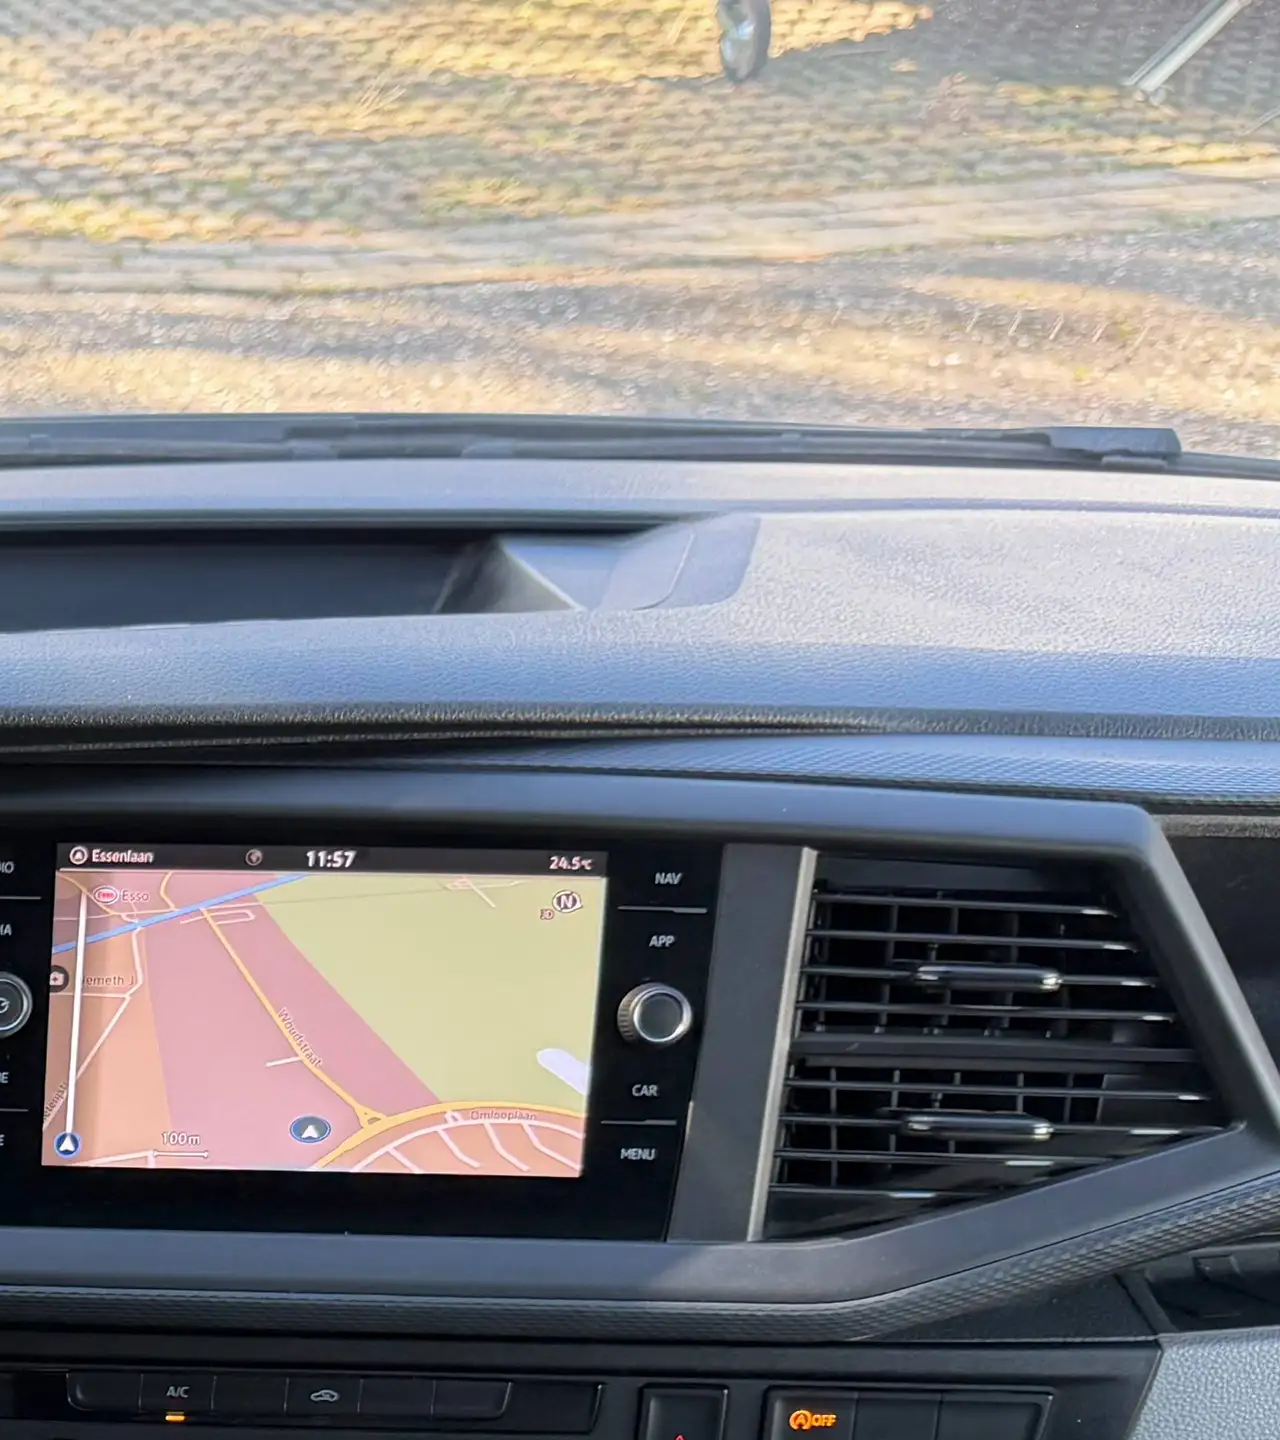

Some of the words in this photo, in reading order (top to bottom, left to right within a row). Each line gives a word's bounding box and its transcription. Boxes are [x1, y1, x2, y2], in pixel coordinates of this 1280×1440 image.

[92, 850, 153, 864] Essenlaan
[306, 850, 357, 868] 11:57
[654, 872, 682, 885] NAV
[122, 889, 149, 903] Esso
[648, 935, 675, 948] APP
[631, 1084, 658, 1097] CAR
[470, 1110, 537, 1122] Omlooplaan
[620, 1148, 656, 1161] MENU
[166, 1385, 190, 1398] A/C
[812, 1414, 837, 1427] OFF
